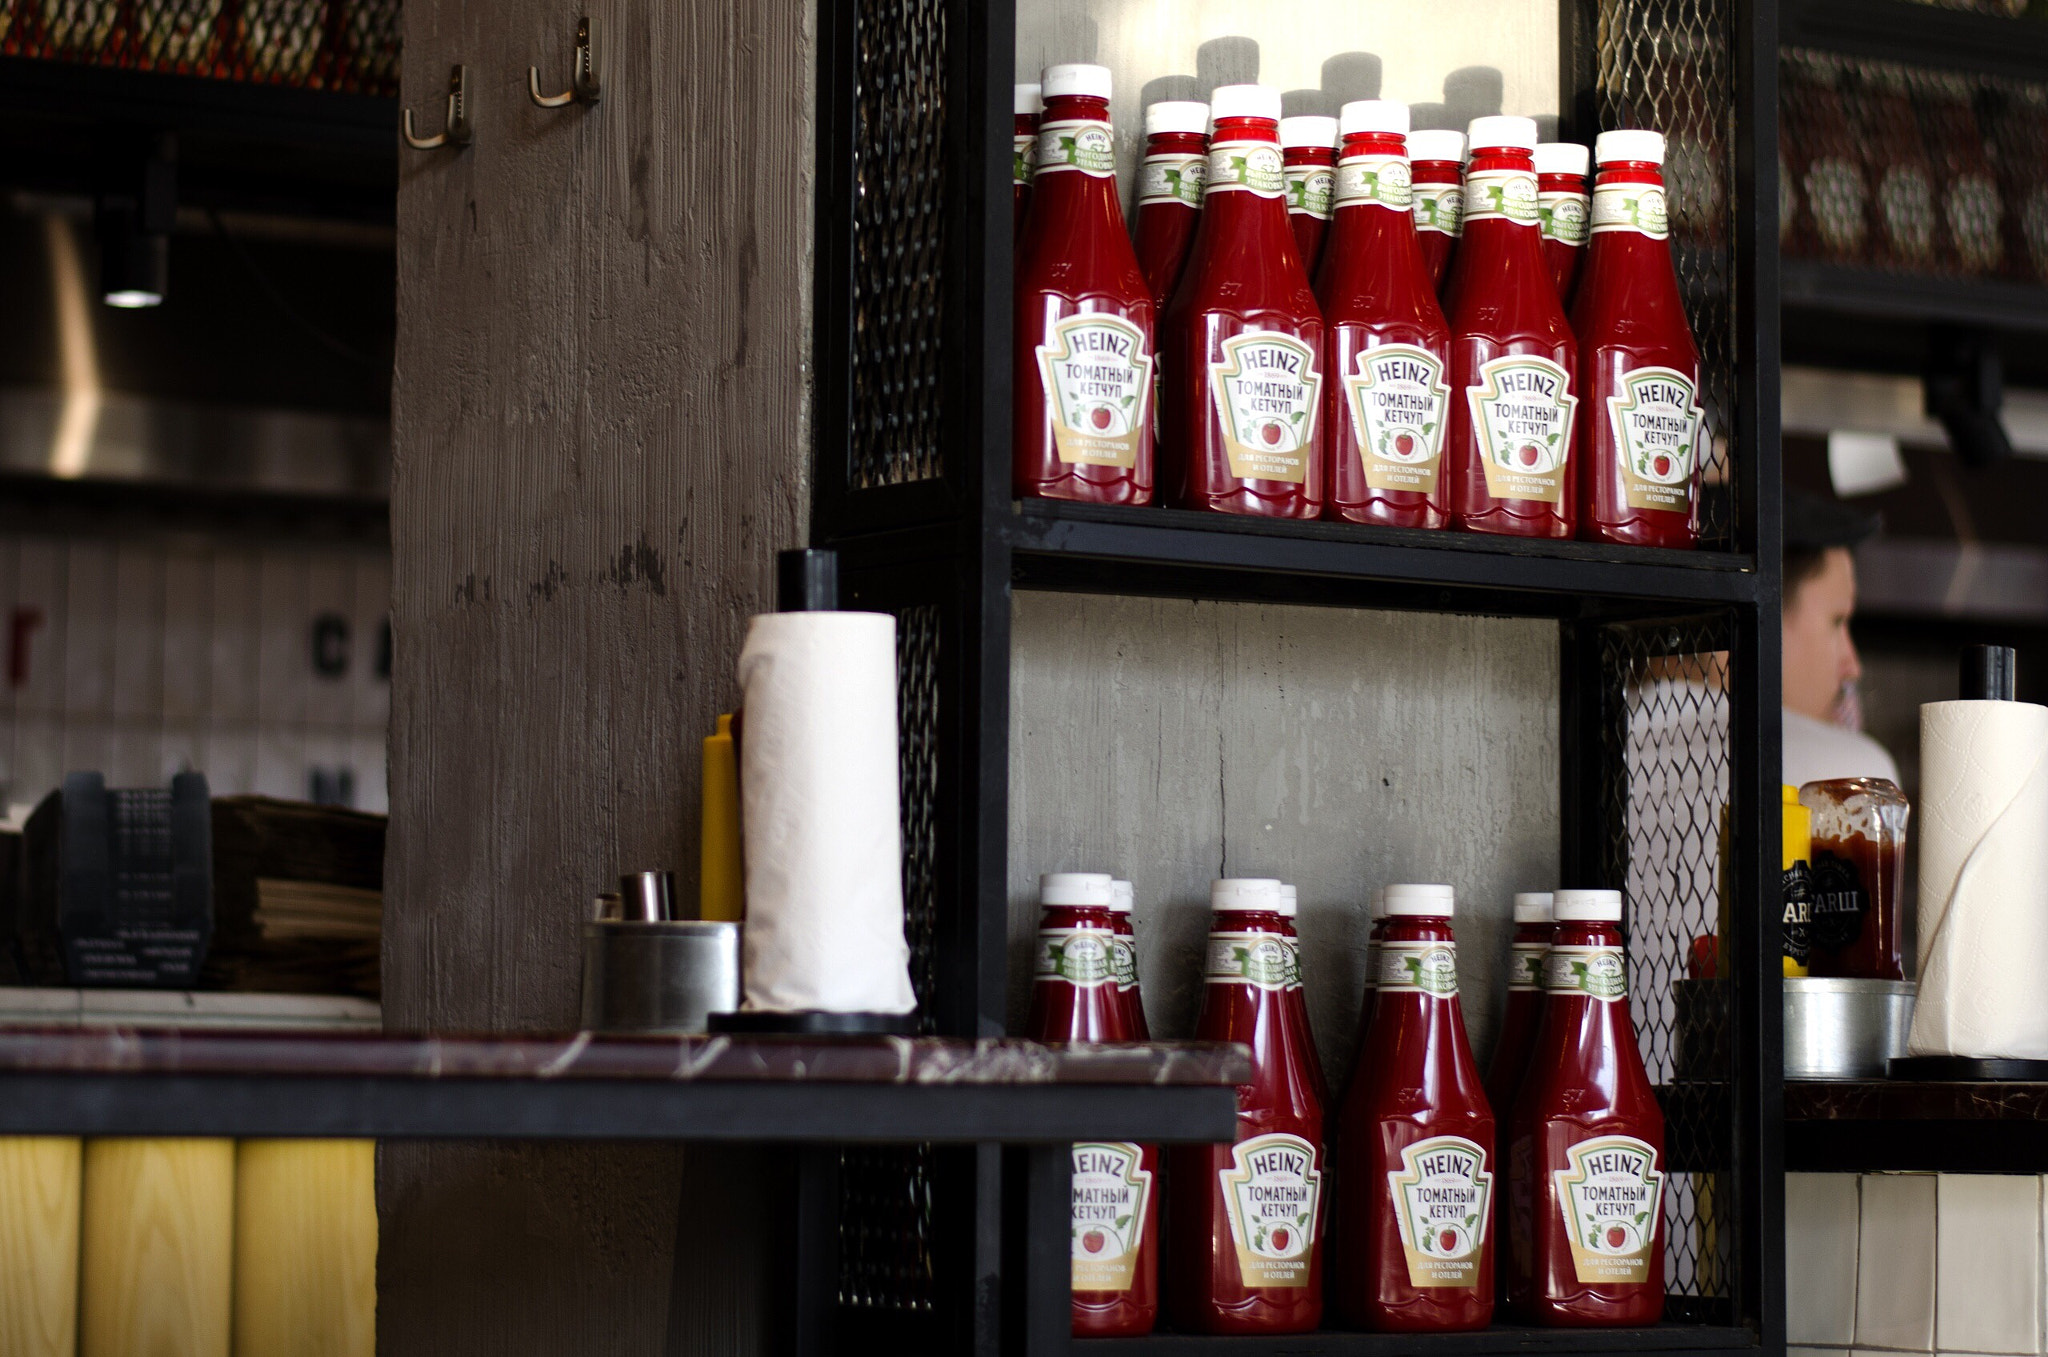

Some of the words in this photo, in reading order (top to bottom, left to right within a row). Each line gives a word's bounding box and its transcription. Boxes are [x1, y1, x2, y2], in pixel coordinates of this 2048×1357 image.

[1085, 133, 1106, 143] HEINZ
[1090, 143, 1106, 152] 57
[1190, 164, 1207, 175] HEIN
[1073, 332, 1129, 358] HEINZ
[1243, 349, 1299, 375] HEINZ
[1065, 364, 1133, 384] ТОМАТНЫЙ
[1378, 361, 1429, 386] HEINZ
[1080, 382, 1122, 398] КЕТЧУП
[1237, 380, 1303, 400] ТОМАТНЫЙ
[1501, 373, 1555, 398] HEINZ
[1372, 392, 1433, 412] ТОМАТНЫЙ
[1638, 384, 1684, 409] HEINZ
[1250, 398, 1291, 414] КЕТЧУП
[1494, 403, 1558, 423] ТОМАТНЫЙ
[1385, 409, 1423, 425] КЕТЧУП
[1632, 413, 1687, 434] ТОМАТНЫЙ
[1508, 420, 1548, 436] КЕТЧУП
[1644, 430, 1678, 447] КЕТЧУП
[1389, 465, 1431, 476] РЕСТОРАНОВ
[1393, 475, 1420, 484] ОТЕЛЕЙ
[1512, 476, 1555, 486] РЕСТОРАНОВ
[1649, 485, 1685, 496] РЕСТОРАНОВ
[1431, 954, 1450, 963] HEINZ
[1597, 960, 1617, 968] HEINZ
[1254, 1152, 1303, 1176] HEINZ
[1422, 1154, 1472, 1178] HEINZ
[1588, 1153, 1642, 1177] HEINZ
[1248, 1184, 1307, 1202] ТОМАТНЫЙ
[1416, 1185, 1476, 1203] ТОМАТНЫЙ
[1582, 1184, 1646, 1201] ТОМАТНЫЙ
[1261, 1203, 1298, 1217] КЕТЧУП
[1429, 1204, 1466, 1218] КЕТЧУП
[1596, 1202, 1636, 1216] КЕТЧУП
